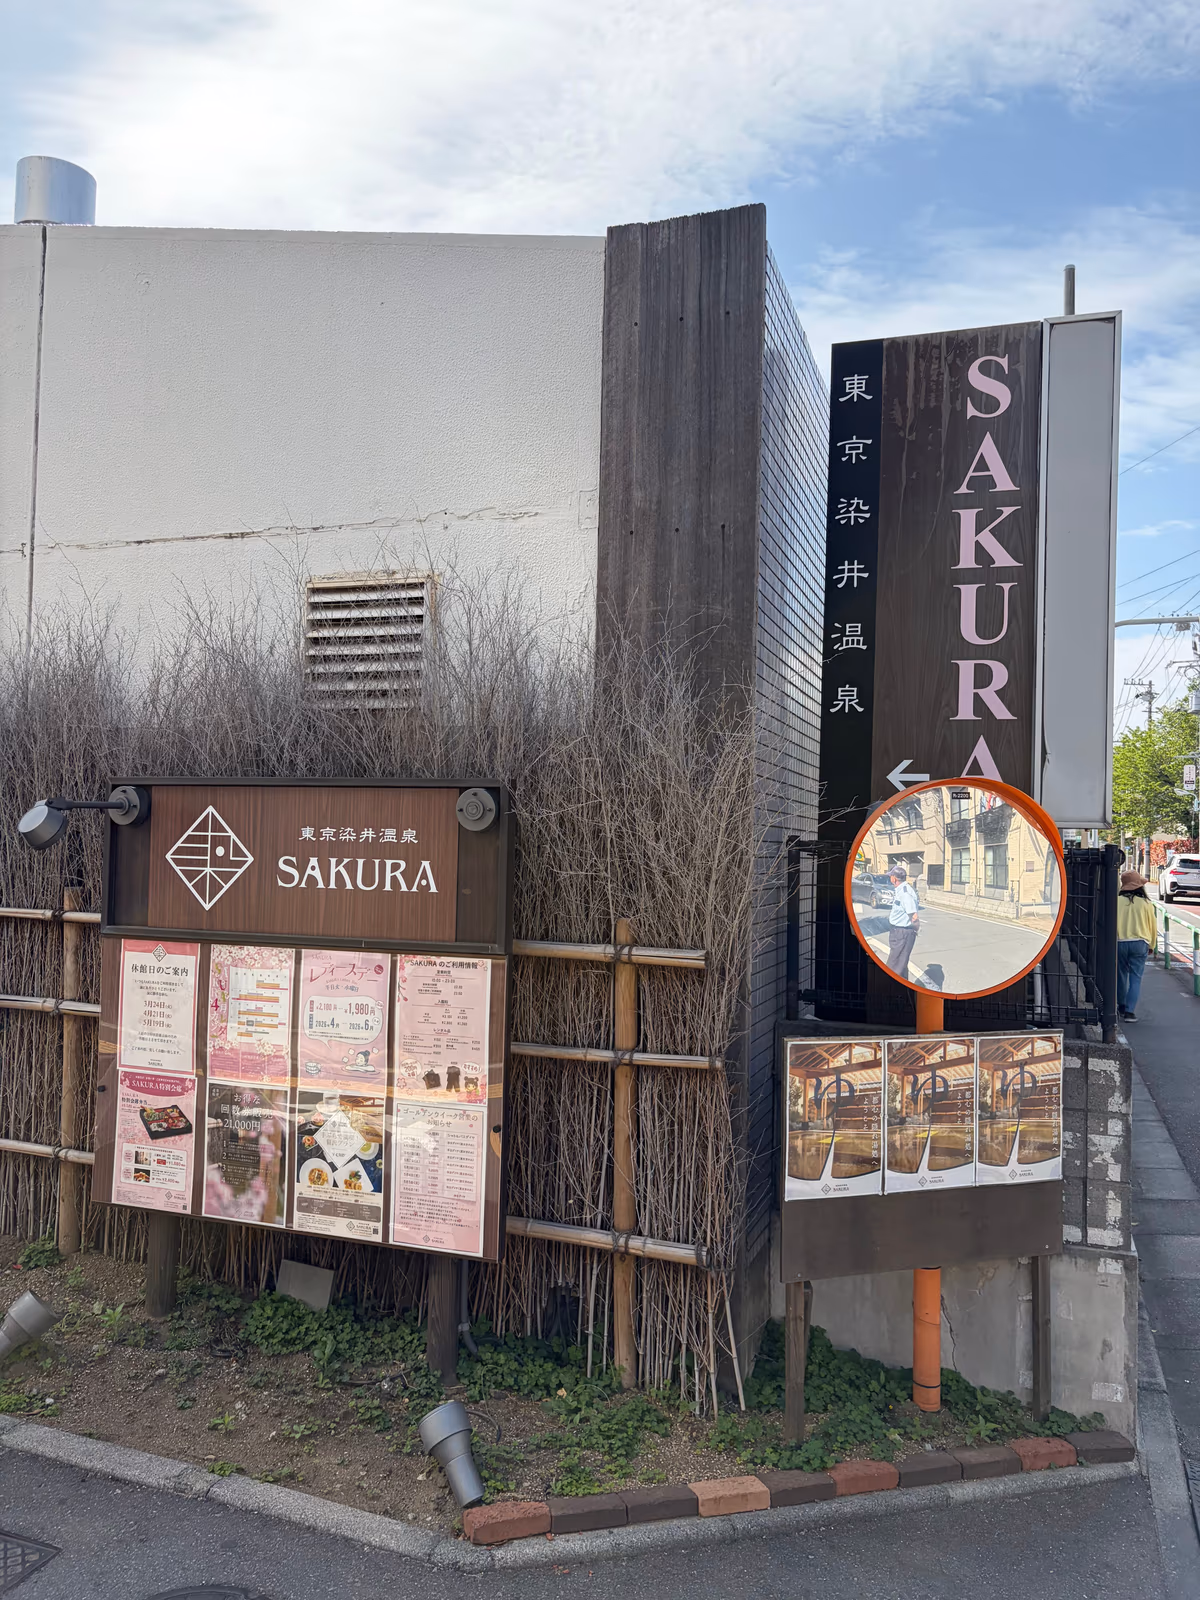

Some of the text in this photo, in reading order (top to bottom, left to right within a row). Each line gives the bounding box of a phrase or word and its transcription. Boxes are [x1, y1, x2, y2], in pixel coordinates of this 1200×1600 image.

[829, 373, 873, 714] 東京染井温泉
[949, 354, 1024, 784] SAKURA
[299, 826, 419, 844] 東京染井温泉
[276, 855, 439, 893] SAKURA
[131, 963, 189, 977] 休館日のご案内
[310, 962, 379, 983] レディースデー
[234, 1093, 260, 1105] お得な
[223, 1118, 261, 1132] 21,000円
